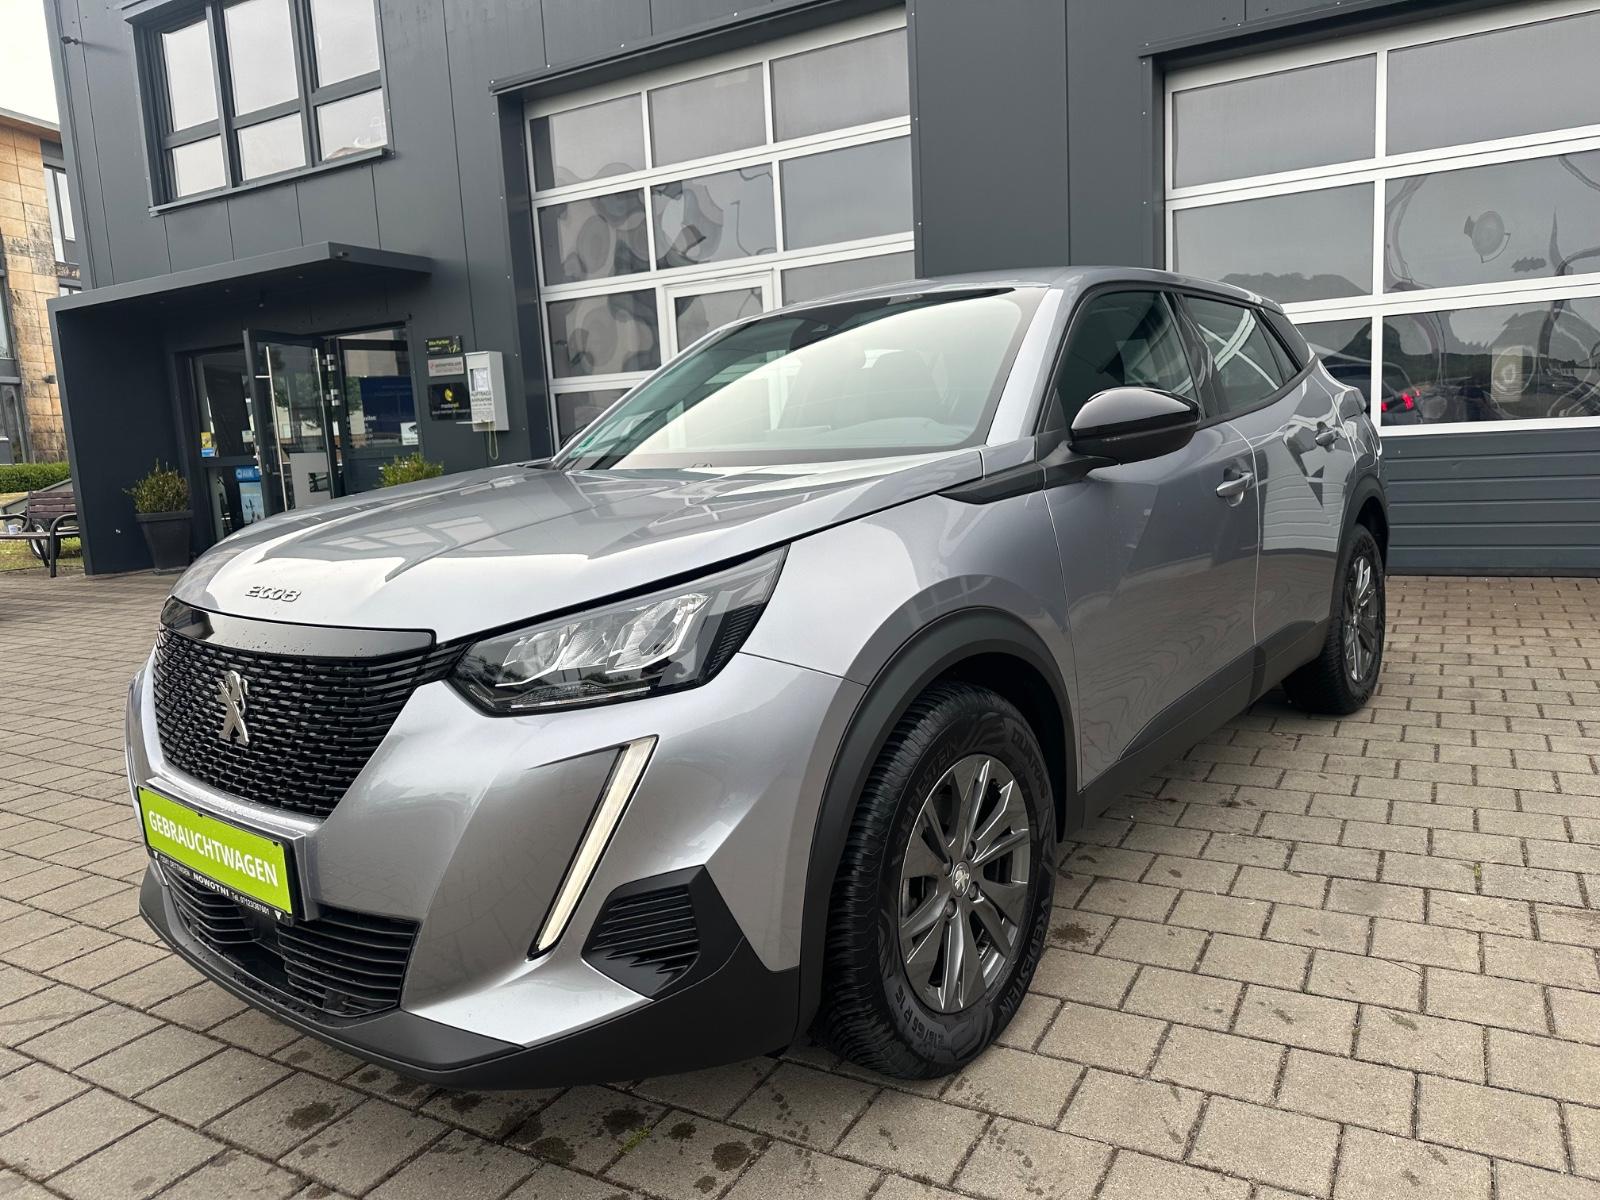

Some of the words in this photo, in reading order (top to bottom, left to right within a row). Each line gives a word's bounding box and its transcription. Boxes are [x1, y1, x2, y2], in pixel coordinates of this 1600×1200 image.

[245, 585, 302, 603] 2008
[148, 810, 279, 888] GEBRAUCHTWAGEN
[999, 896, 1051, 1018] VREDESTEIN
